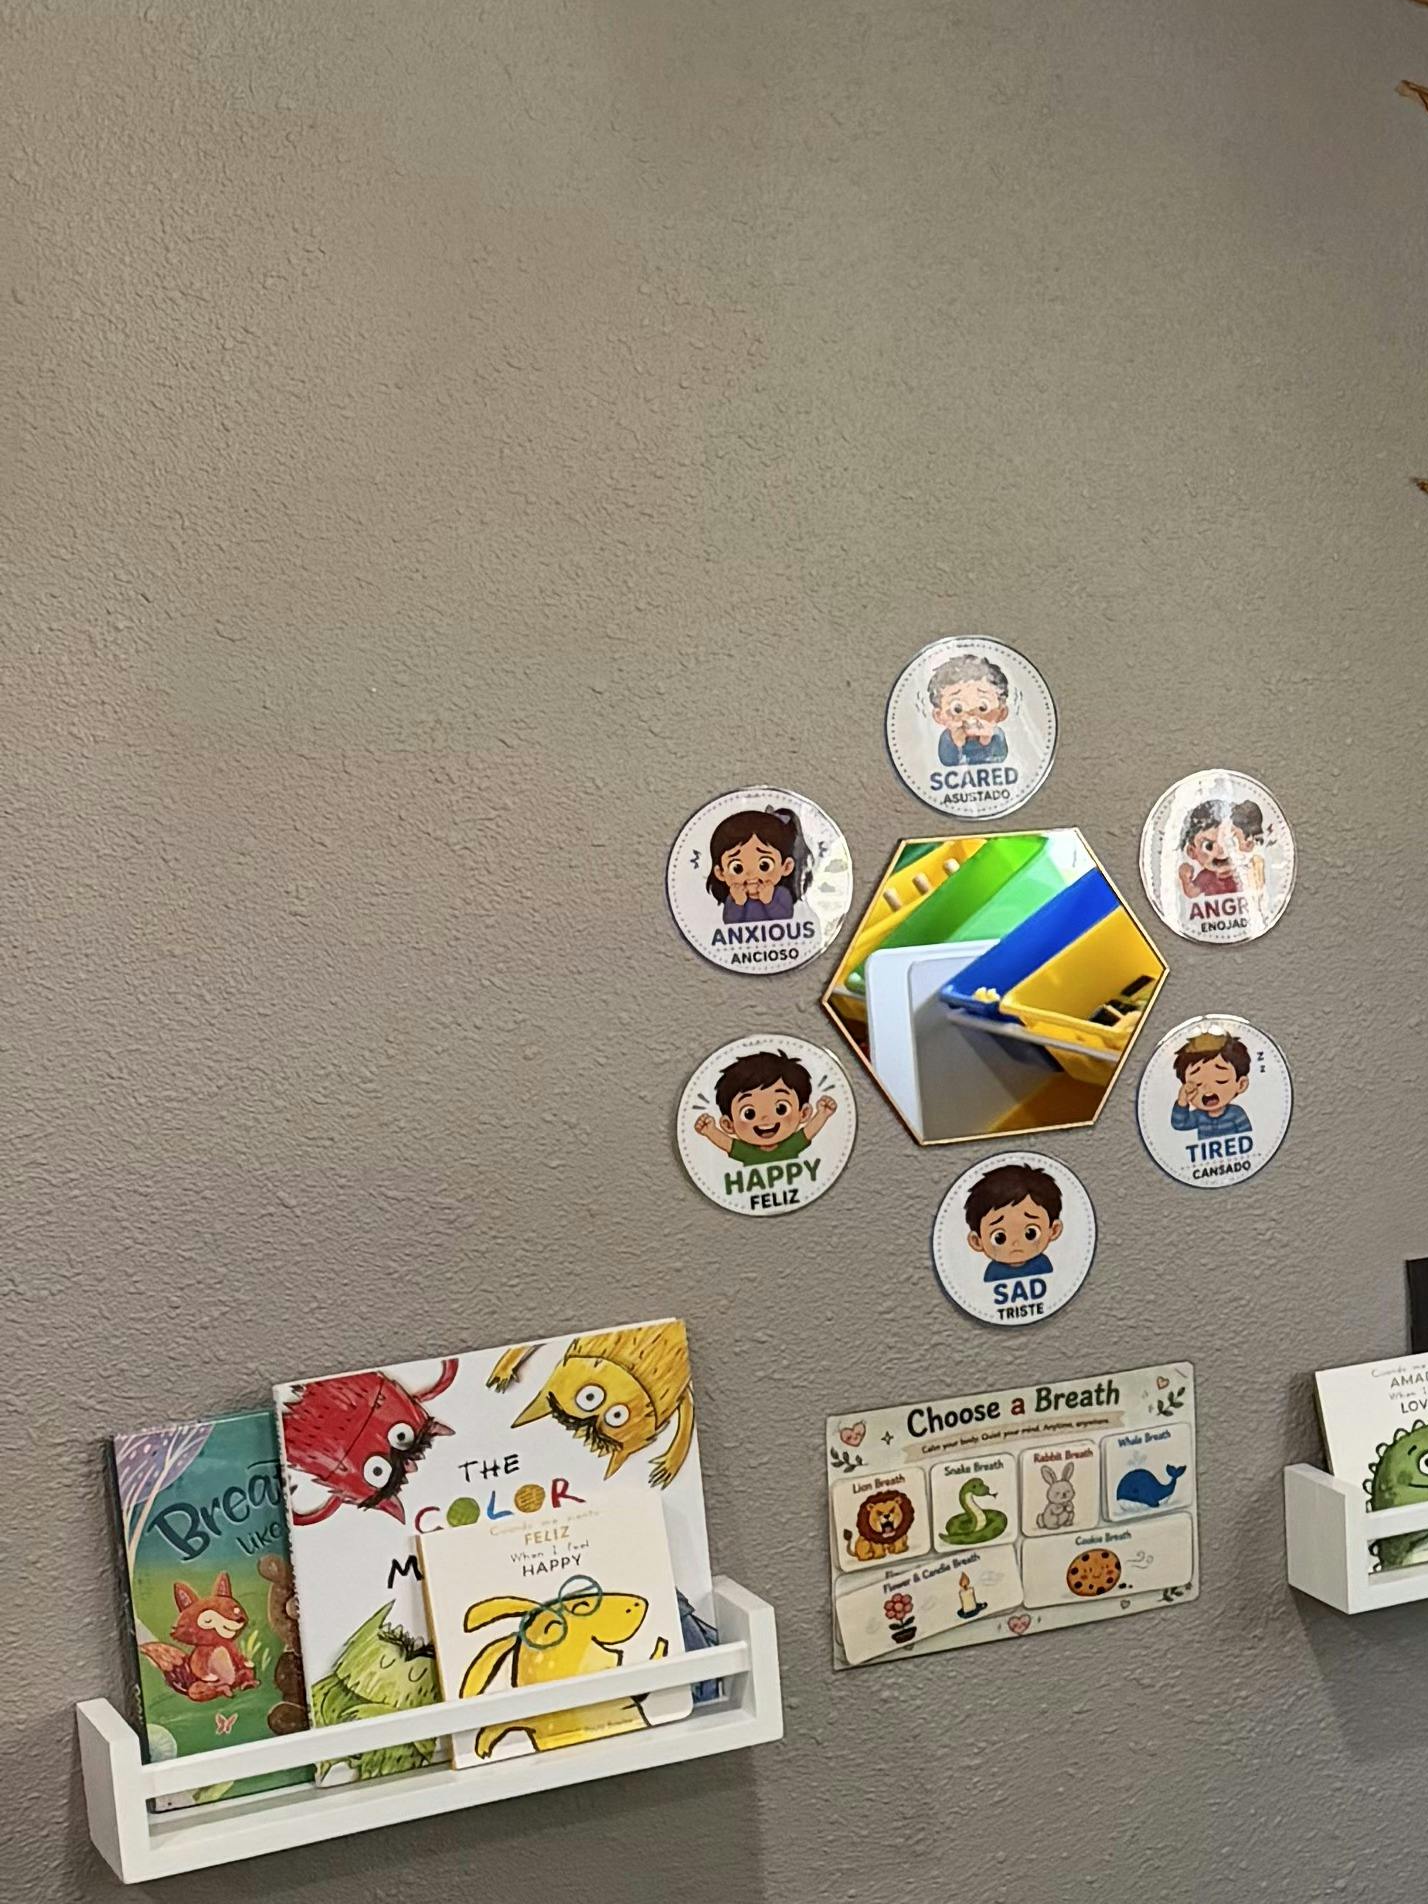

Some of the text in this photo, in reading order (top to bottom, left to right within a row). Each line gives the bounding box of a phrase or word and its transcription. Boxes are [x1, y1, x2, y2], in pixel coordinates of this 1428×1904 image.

[930, 767, 1018, 791] SCARED
[944, 789, 1011, 804] ASUSTADO
[711, 921, 815, 946] ANXIOUS
[730, 948, 800, 965] ANCIOSO
[1185, 1135, 1254, 1163] TIRED
[724, 1158, 821, 1195] HAPPY
[1192, 1160, 1252, 1180] CANSADO
[750, 1188, 801, 1210] FELIZ
[993, 1277, 1047, 1305] SAD
[997, 1302, 1045, 1320] TRISTE
[907, 1379, 1121, 1438] Choose a Breath
[1118, 1429, 1172, 1447] Whale Breath
[1033, 1447, 1094, 1463] Rabbit Breath
[458, 1454, 520, 1482] THE
[944, 1458, 1004, 1477] Snake Breath
[852, 1473, 906, 1494] Lion Breath
[414, 1478, 587, 1534] COLOR
[524, 1525, 570, 1546] FELIZ
[1074, 1529, 1132, 1546] Cookie Breath
[522, 1553, 582, 1577] HAPPY
[883, 1578, 910, 1595] Flower
[922, 1563, 951, 1581] Candle
[952, 1553, 981, 1571] Breath
